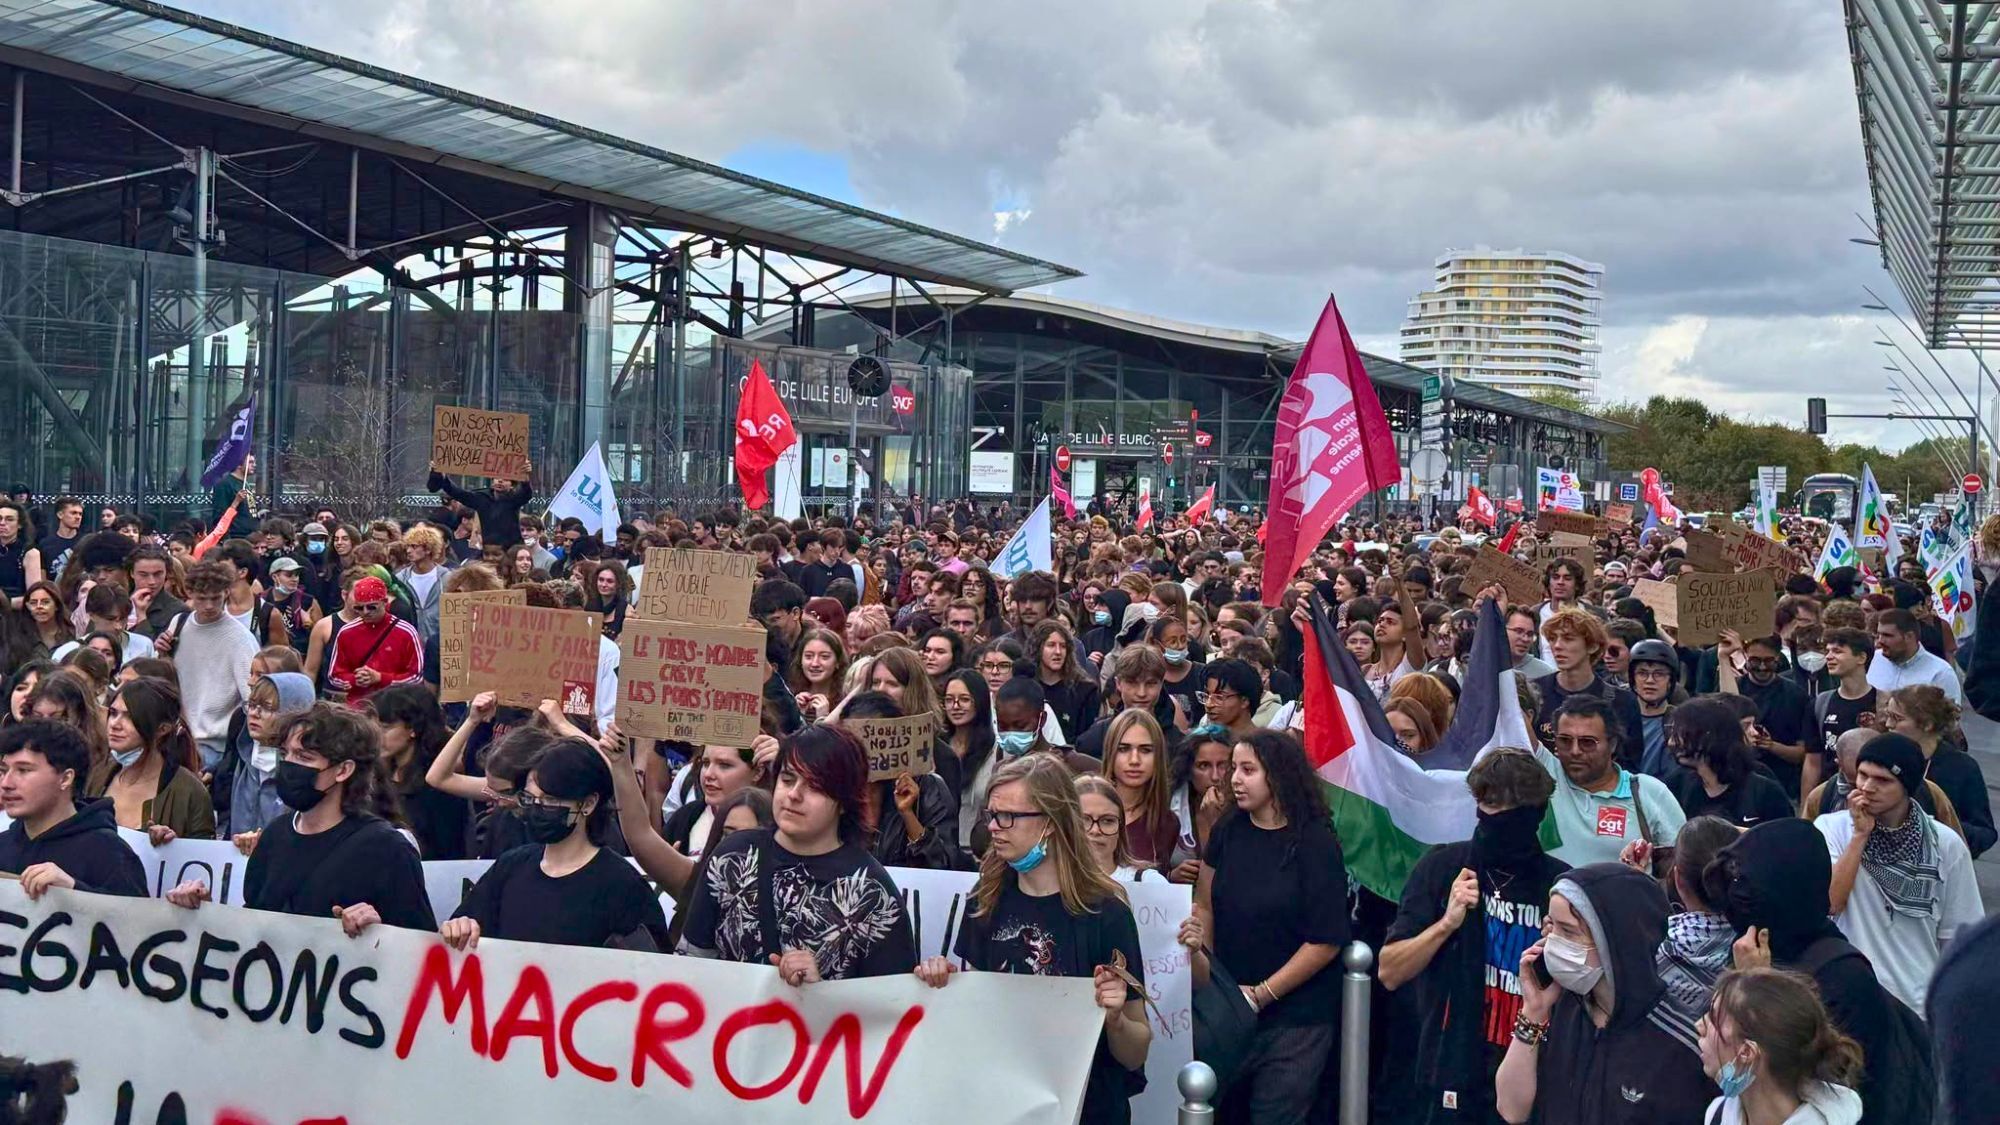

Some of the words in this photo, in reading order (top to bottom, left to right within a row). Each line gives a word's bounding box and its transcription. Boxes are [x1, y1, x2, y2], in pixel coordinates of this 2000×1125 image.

[780, 381, 797, 400] DE
[801, 384, 829, 404] LILLE
[891, 395, 914, 411] SNCF
[441, 411, 460, 428] ON
[467, 413, 504, 434] SORT
[495, 431, 525, 453] MAIS
[1743, 531, 1766, 552] POUR
[1734, 543, 1758, 569] POUR
[645, 570, 669, 593] T'AS
[1688, 579, 1745, 599] SOUTIEN
[491, 605, 513, 628] ON
[519, 609, 573, 632] AVAIT
[642, 594, 668, 616] TES
[677, 595, 728, 620] CHIENS
[470, 628, 513, 650] VOULU
[518, 634, 542, 653] SE
[551, 634, 598, 661] FAIRE
[633, 634, 651, 657] LE
[470, 645, 497, 674] BZ
[627, 679, 656, 705] LES
[667, 711, 684, 723] EAT
[686, 712, 706, 723] THE
[862, 725, 897, 739] PROFS
[900, 725, 912, 737] DE
[870, 736, 911, 750] CTION
[1598, 819, 1623, 832] cgt
[395, 942, 925, 1120] MACRON
